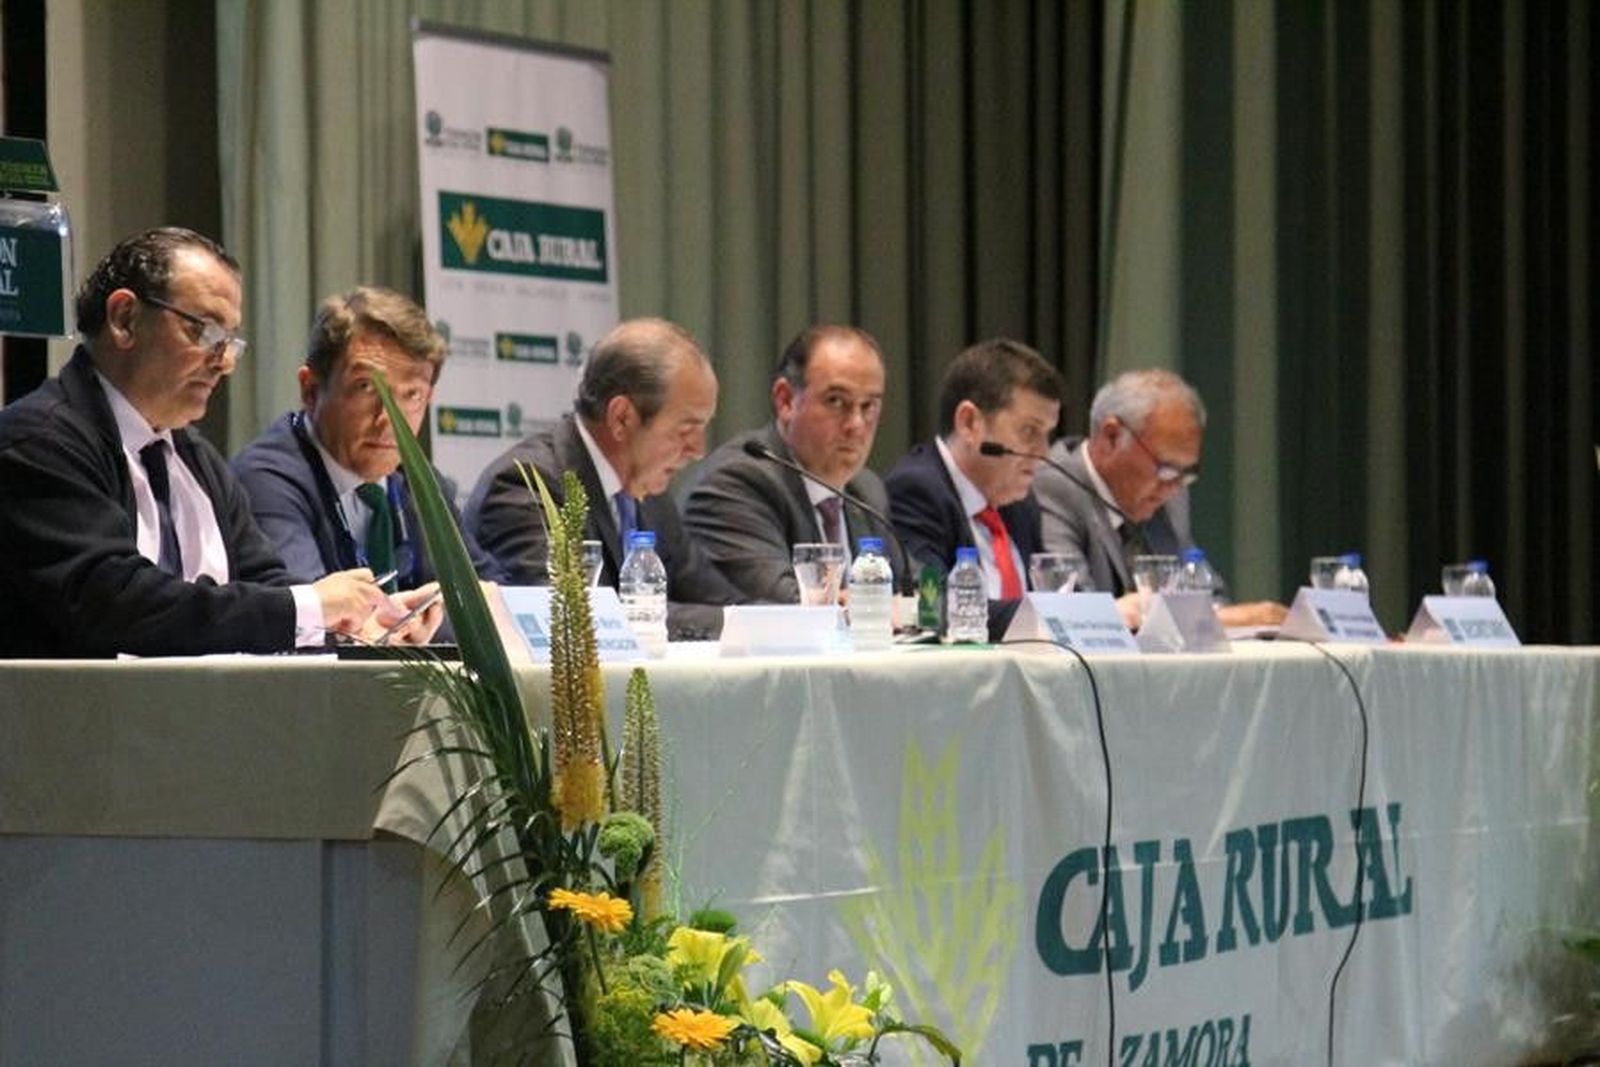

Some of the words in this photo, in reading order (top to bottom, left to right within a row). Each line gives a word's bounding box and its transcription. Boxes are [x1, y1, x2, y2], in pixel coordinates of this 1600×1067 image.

[1036, 838, 1208, 992] CAJA
[1217, 803, 1412, 953] RURAL
[1119, 1014, 1251, 1067] ZAMORA
